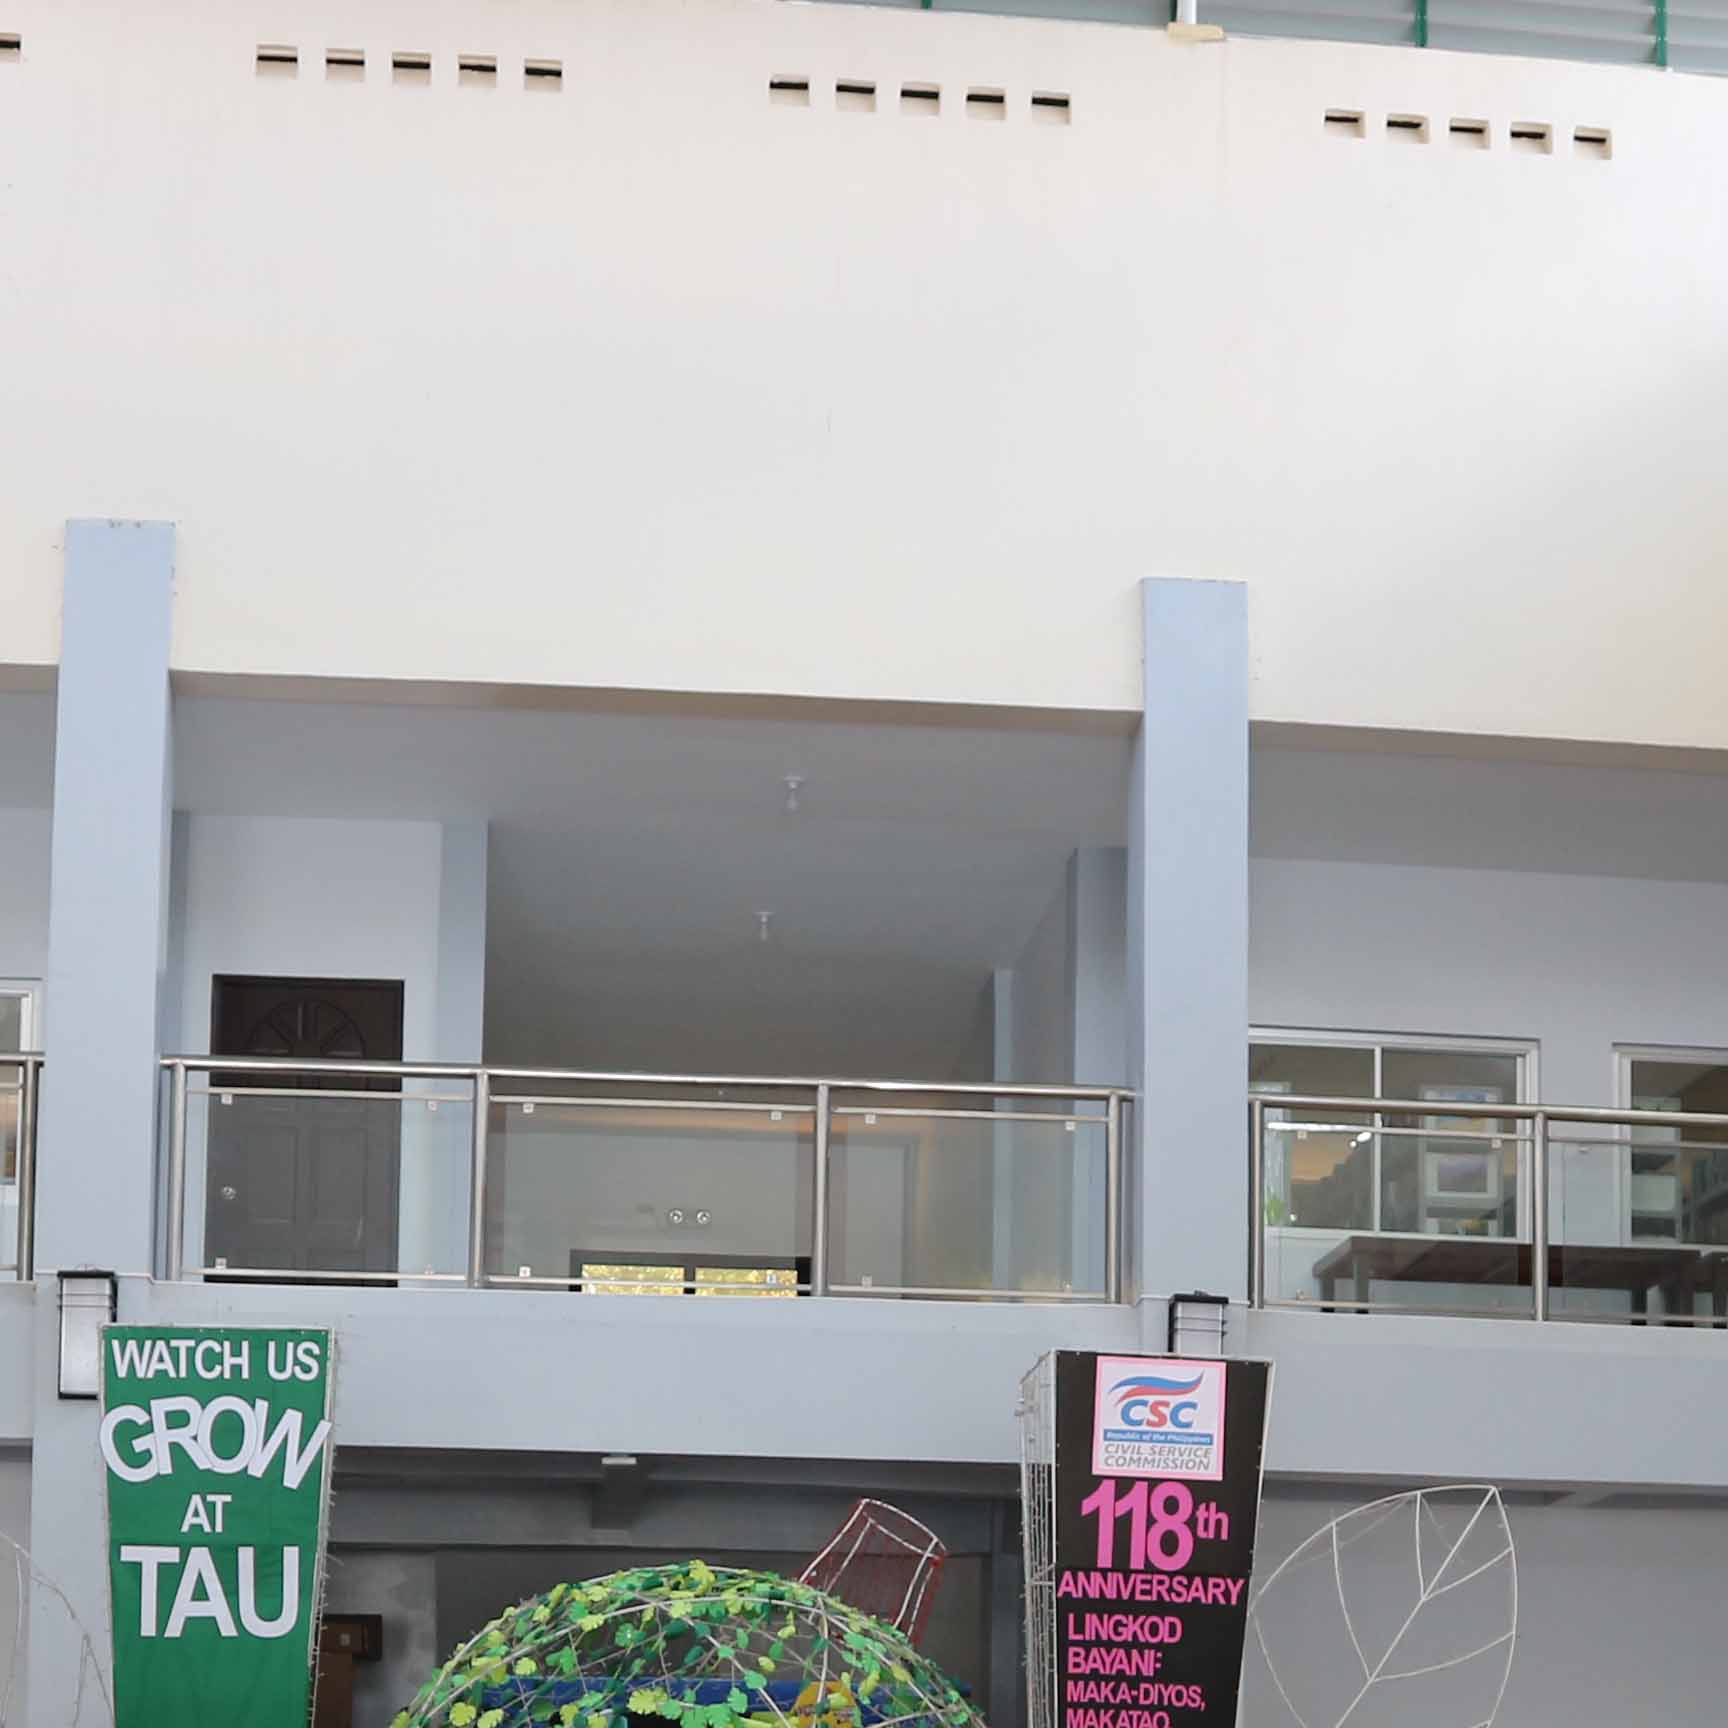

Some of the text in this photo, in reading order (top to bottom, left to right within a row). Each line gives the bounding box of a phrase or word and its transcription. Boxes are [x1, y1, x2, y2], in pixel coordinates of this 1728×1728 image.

[112, 1338, 321, 1382] WATCH US
[1120, 1399, 1198, 1429] CSC
[99, 1394, 331, 1490] GROW
[1104, 1443, 1213, 1459] CIVIL SERVICE
[1104, 1455, 1210, 1471] COMMISSION
[180, 1494, 232, 1533] AT
[1080, 1479, 1229, 1572] 118th
[120, 1545, 300, 1639] TAU
[1057, 1571, 1245, 1605] ANNIVERSARY
[1068, 1613, 1183, 1644] LINGKOD
[1067, 1646, 1163, 1676] BAYANI:
[1066, 1680, 1206, 1711] MAKA-DIYOS,
